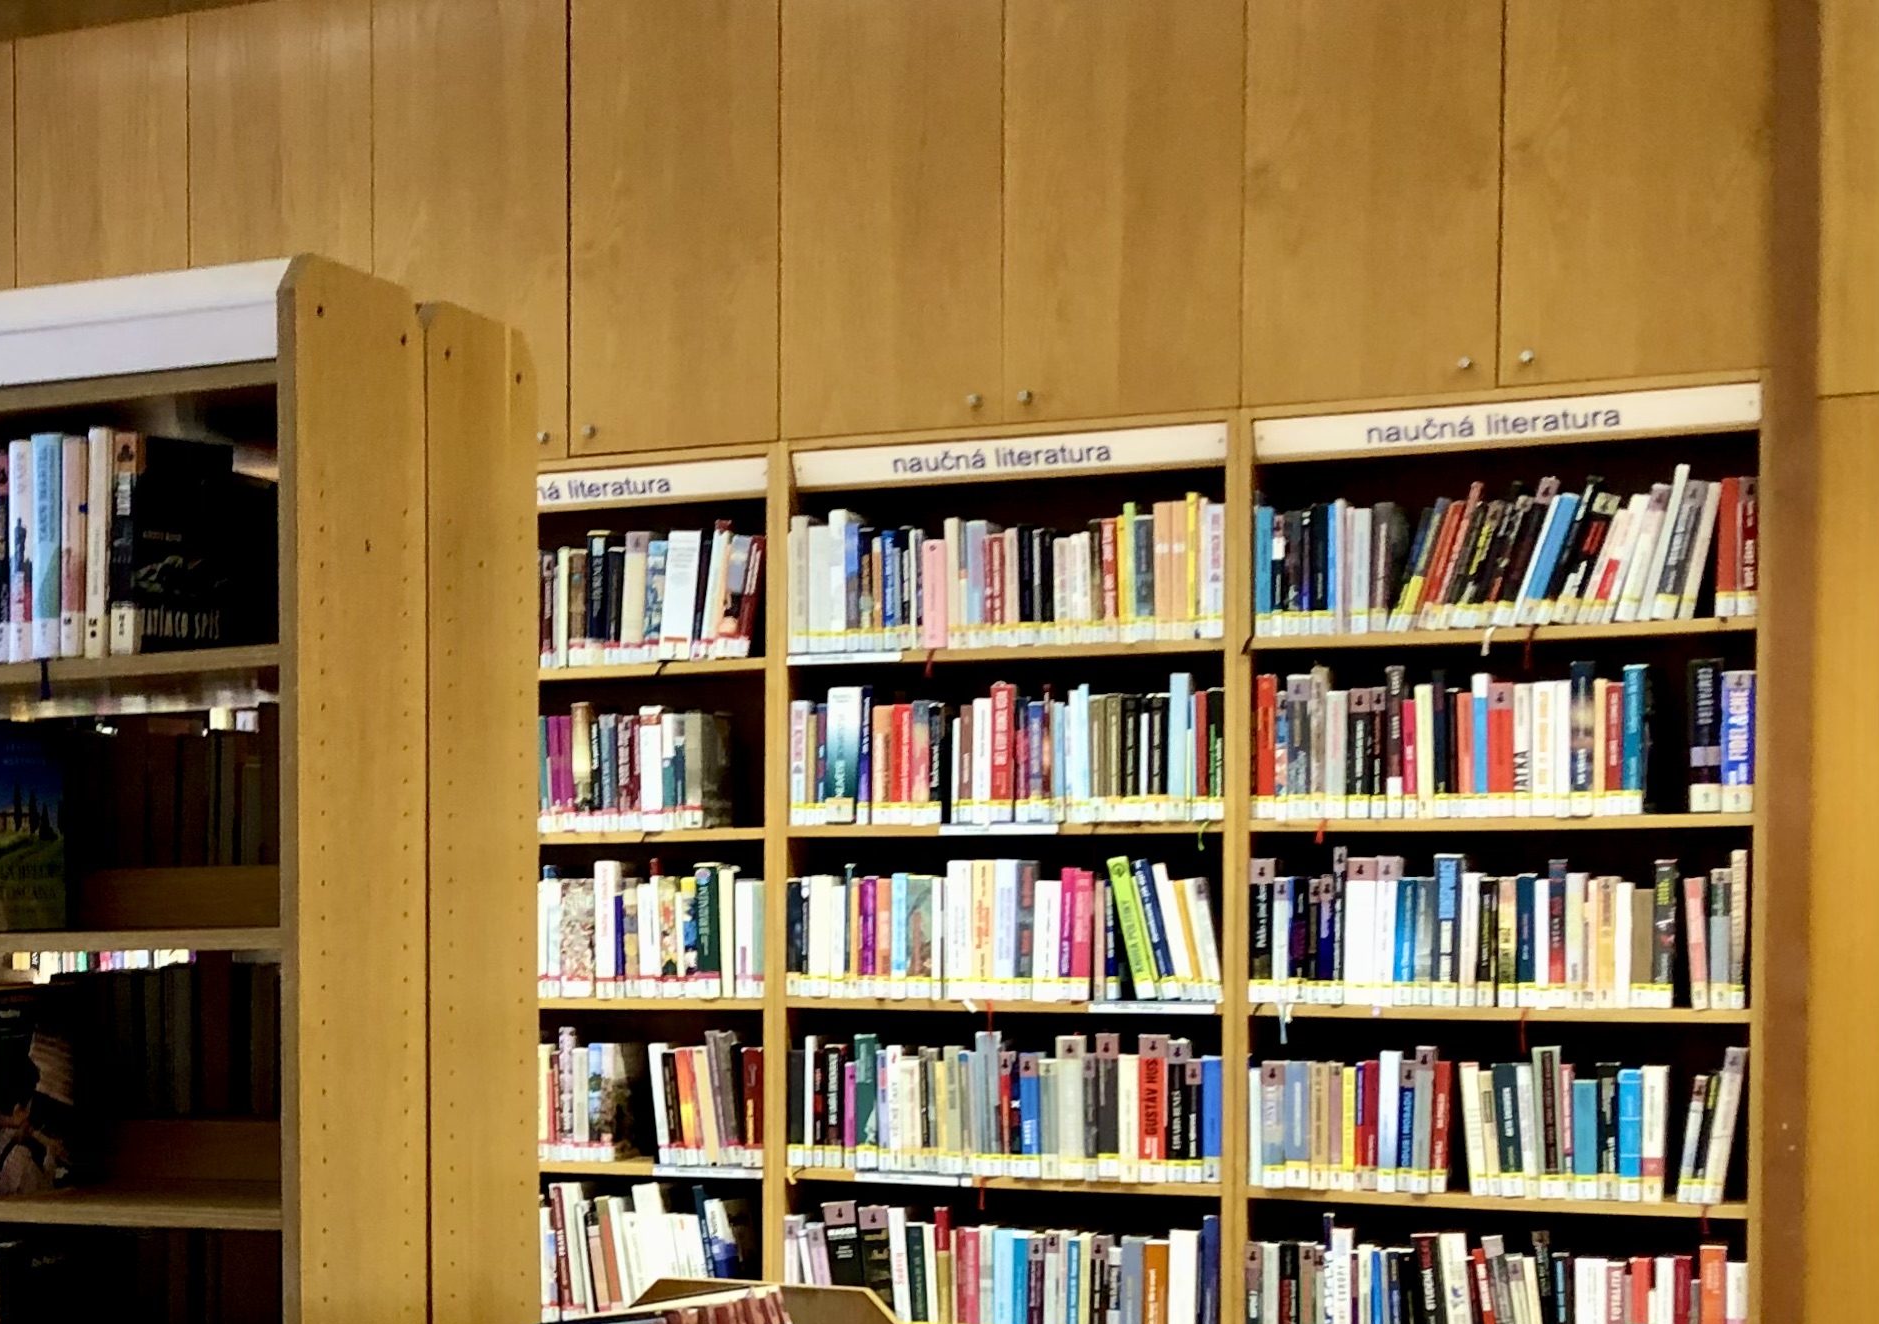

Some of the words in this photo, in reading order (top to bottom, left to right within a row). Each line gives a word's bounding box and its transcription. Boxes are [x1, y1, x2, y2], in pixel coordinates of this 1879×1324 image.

[1366, 414, 1476, 445] naučná
[1486, 406, 1620, 437] literatura
[892, 447, 986, 475] naučná
[995, 440, 1112, 469] literatura
[567, 474, 671, 499] literatura
[1144, 1057, 1158, 1084] HUS
